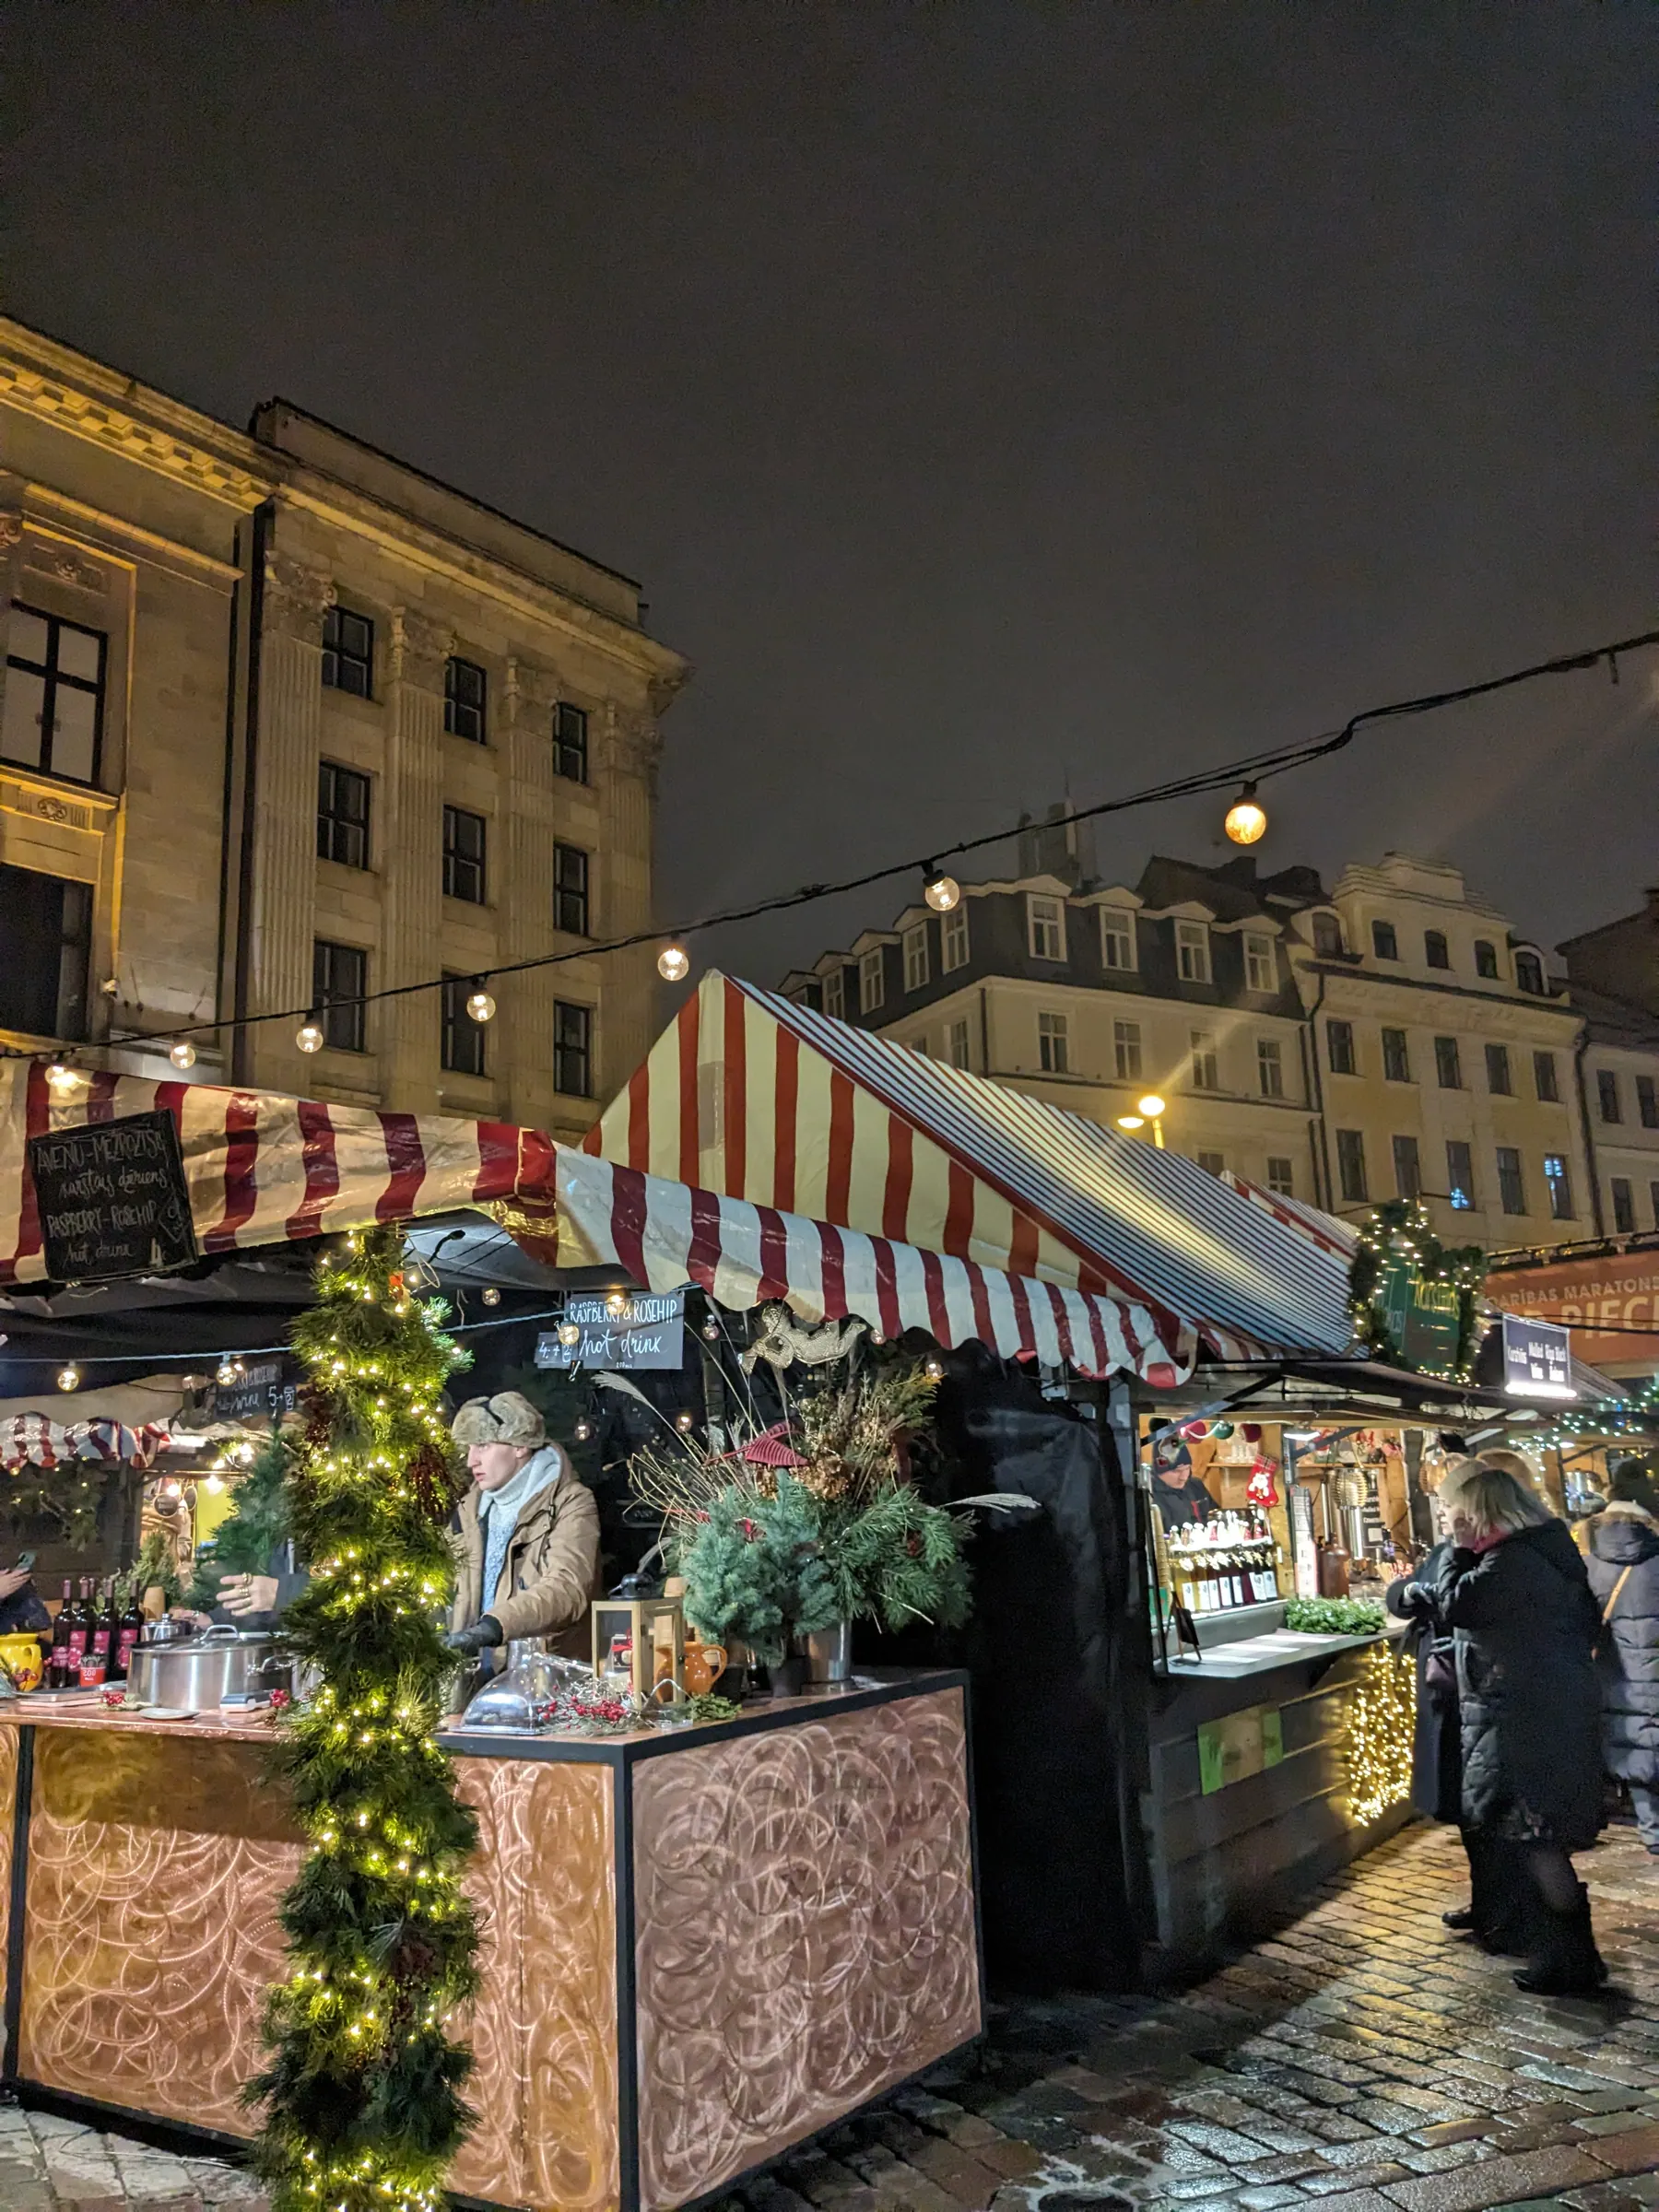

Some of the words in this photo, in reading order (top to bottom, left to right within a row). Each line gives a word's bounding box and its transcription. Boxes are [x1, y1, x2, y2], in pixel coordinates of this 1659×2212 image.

[623, 1301, 633, 1321] &
[633, 1299, 678, 1324] ROSEHIP
[578, 1328, 618, 1359] hot
[620, 1328, 664, 1359] drink
